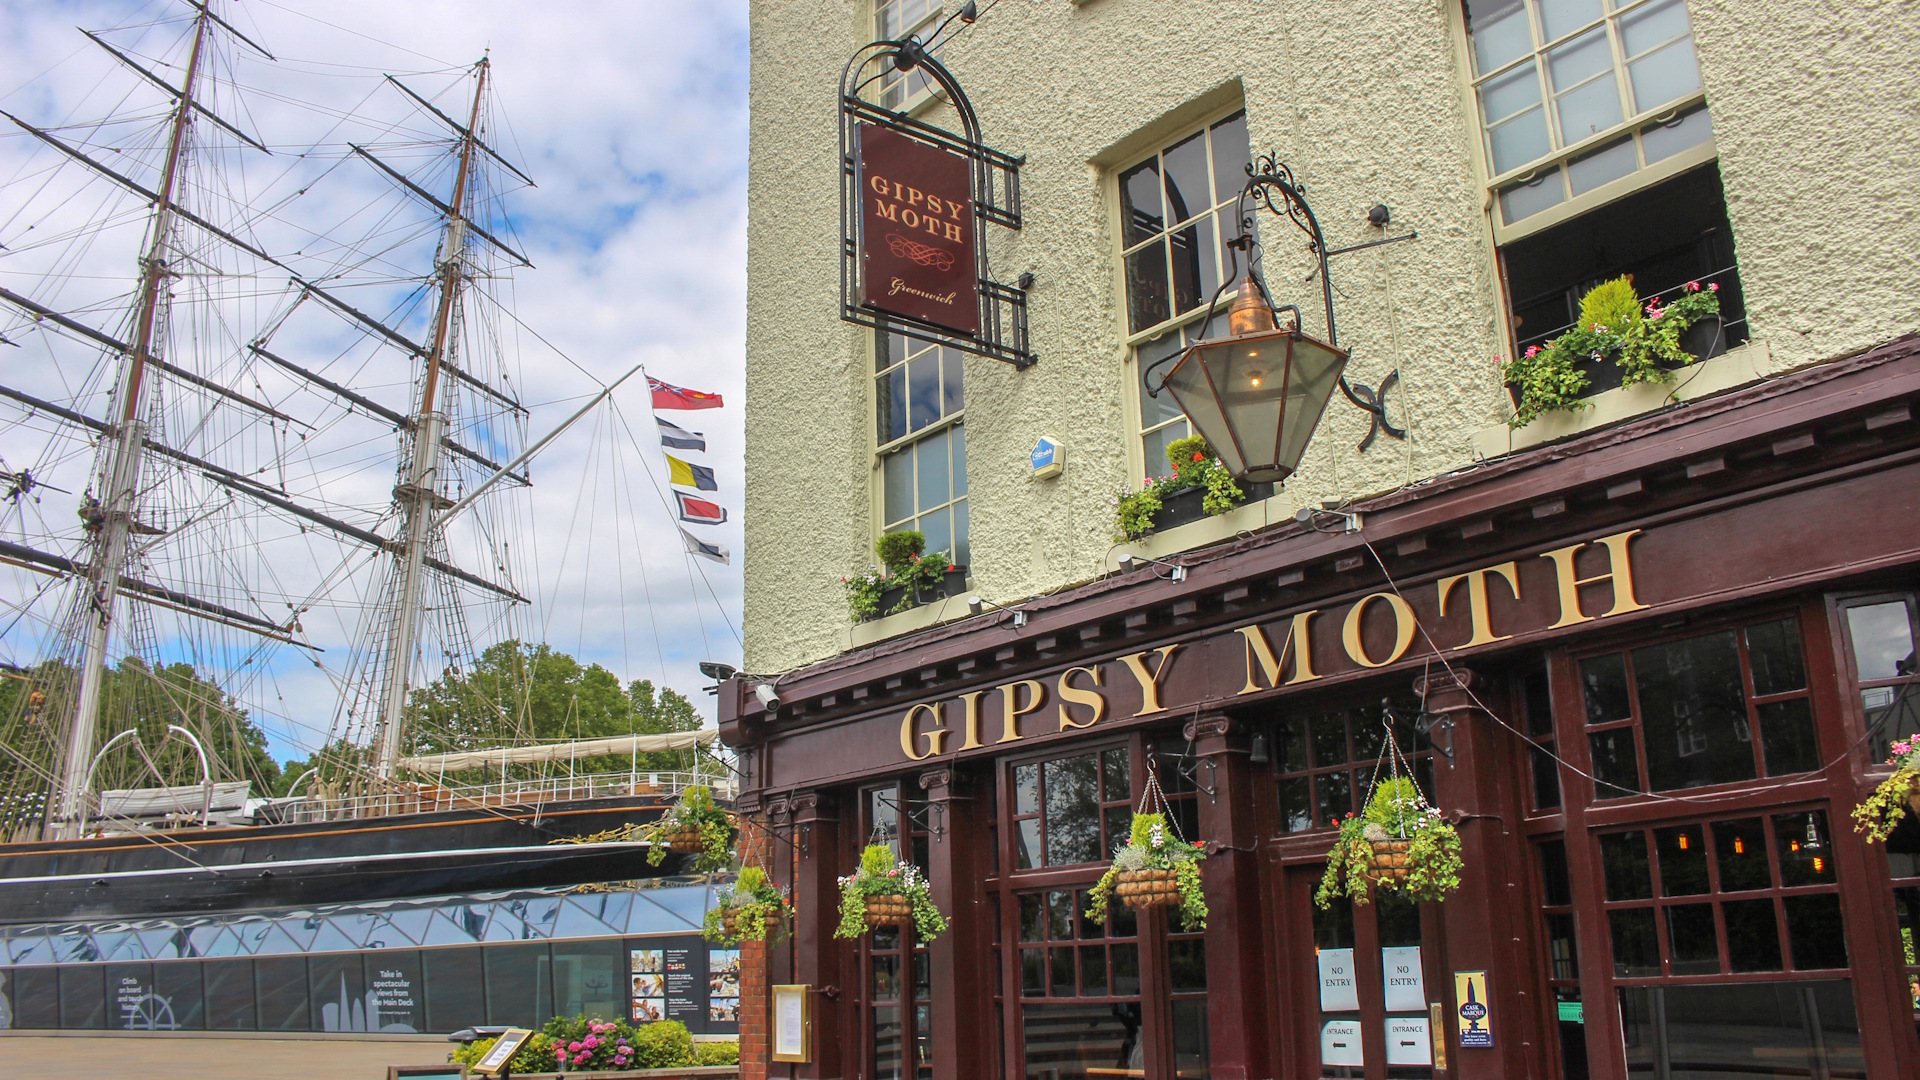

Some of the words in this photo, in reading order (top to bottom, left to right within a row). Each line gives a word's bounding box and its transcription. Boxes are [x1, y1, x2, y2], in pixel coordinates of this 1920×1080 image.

[870, 175, 964, 221] GIPSY
[875, 198, 963, 244] MOTH
[888, 276, 957, 305] Greenwich
[900, 643, 1179, 762] GIPSY
[1234, 528, 1652, 697] MOTH
[380, 970, 395, 978] Take
[396, 969, 403, 978] in
[1331, 966, 1343, 975] NO
[1396, 965, 1409, 974] NO
[122, 977, 138, 985] Climb
[373, 979, 410, 988] spectacular
[1325, 978, 1352, 987] ENTRY
[1390, 977, 1418, 986] ENTRY
[376, 988, 393, 997] views
[393, 988, 409, 997] from
[372, 998, 382, 1006] the
[383, 997, 397, 1006] Main
[398, 998, 414, 1006] Deck
[1392, 1025, 1423, 1033] ENTRANCE
